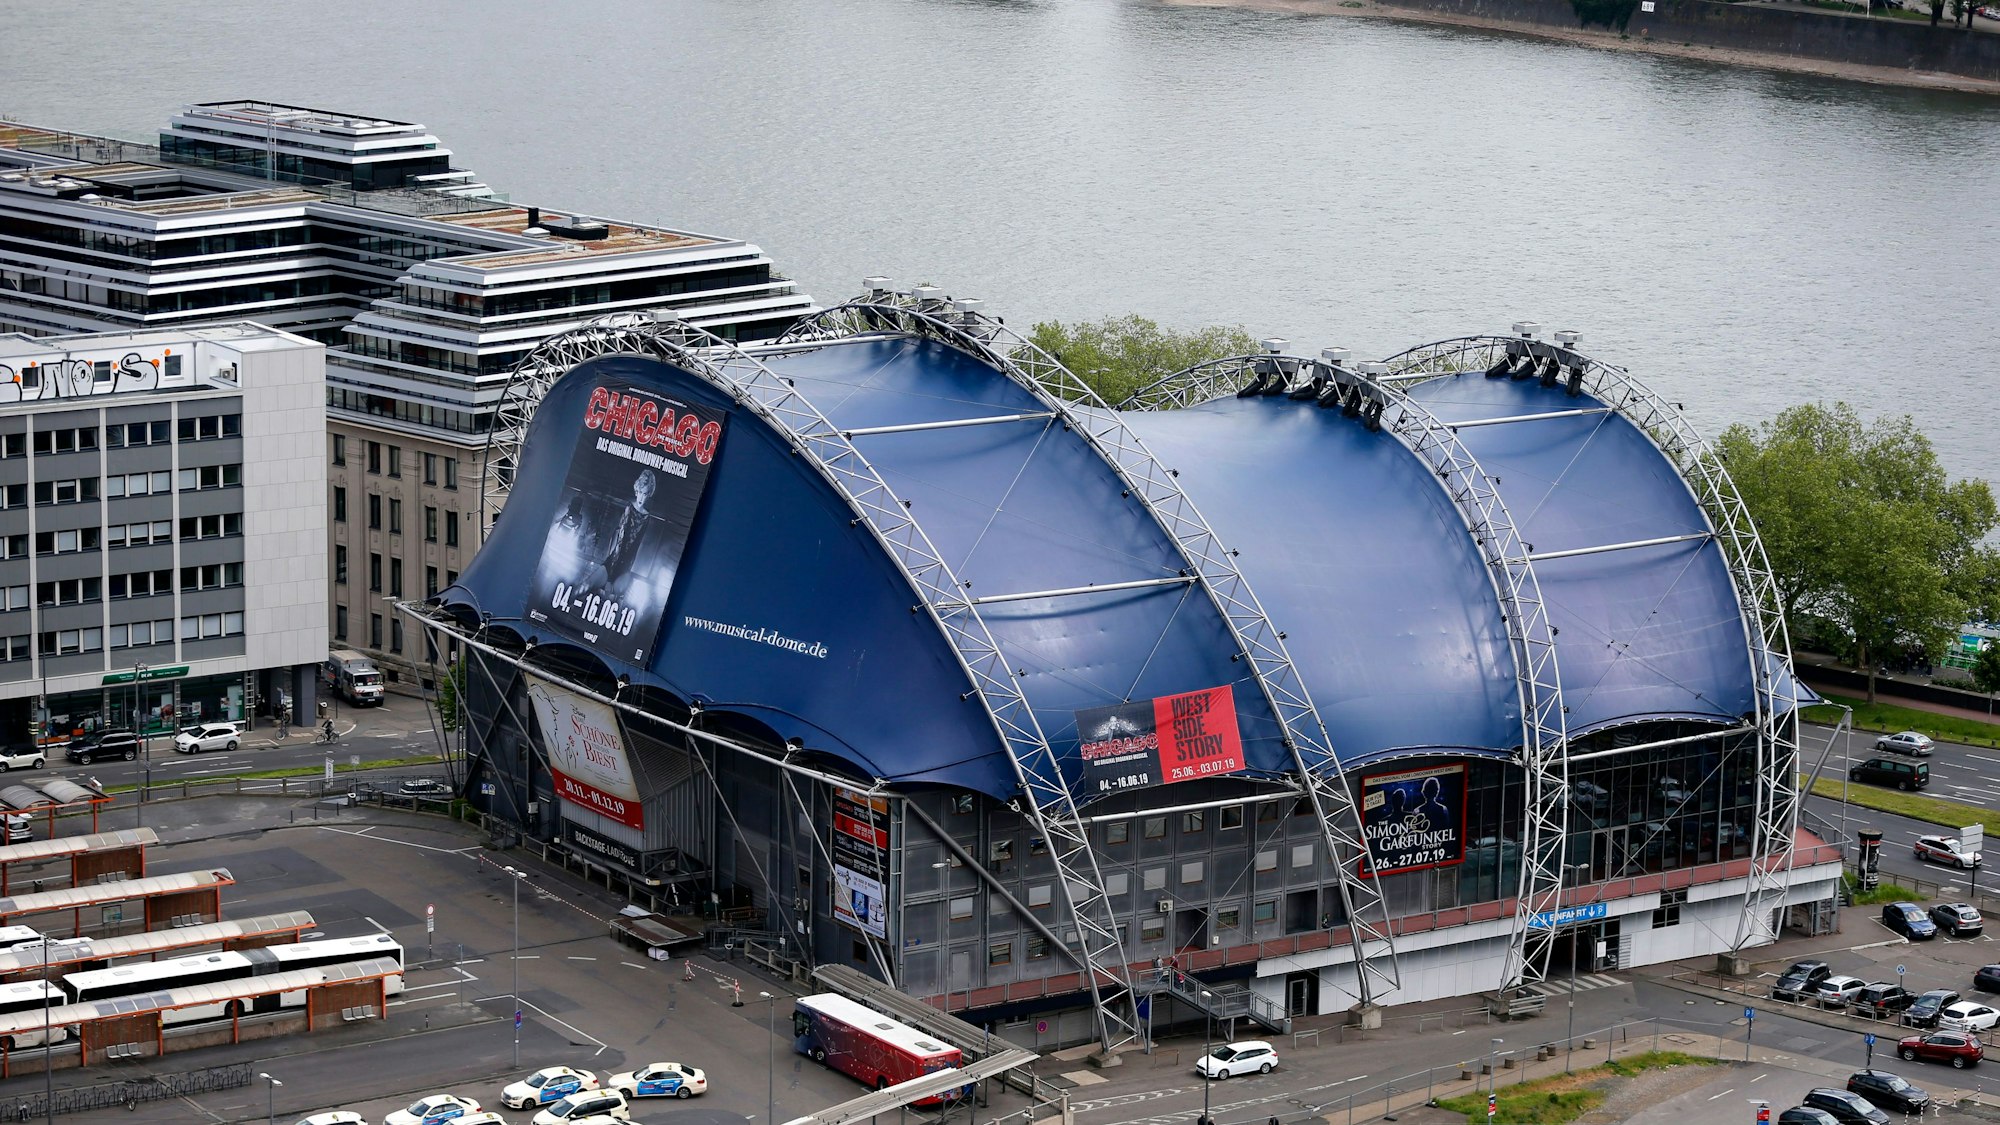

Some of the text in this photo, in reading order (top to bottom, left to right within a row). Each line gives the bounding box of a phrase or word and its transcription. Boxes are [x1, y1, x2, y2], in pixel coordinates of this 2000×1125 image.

[584, 386, 722, 465] CHICAGO
[596, 437, 690, 479] DAS ORIGINAL BROADWAY-MUSICAL
[684, 616, 828, 658] www.musical-dome.de
[1171, 693, 1212, 718] WEST
[571, 714, 621, 750] SCHÖNE
[1173, 716, 1207, 740] SIDE
[583, 739, 617, 770] BIEST
[1080, 733, 1158, 760] CHICAGO
[1176, 733, 1223, 761] STORY
[1365, 821, 1409, 840] SIMON
[1380, 828, 1456, 852] GARFUNKEL
[1422, 842, 1442, 851] STORY
